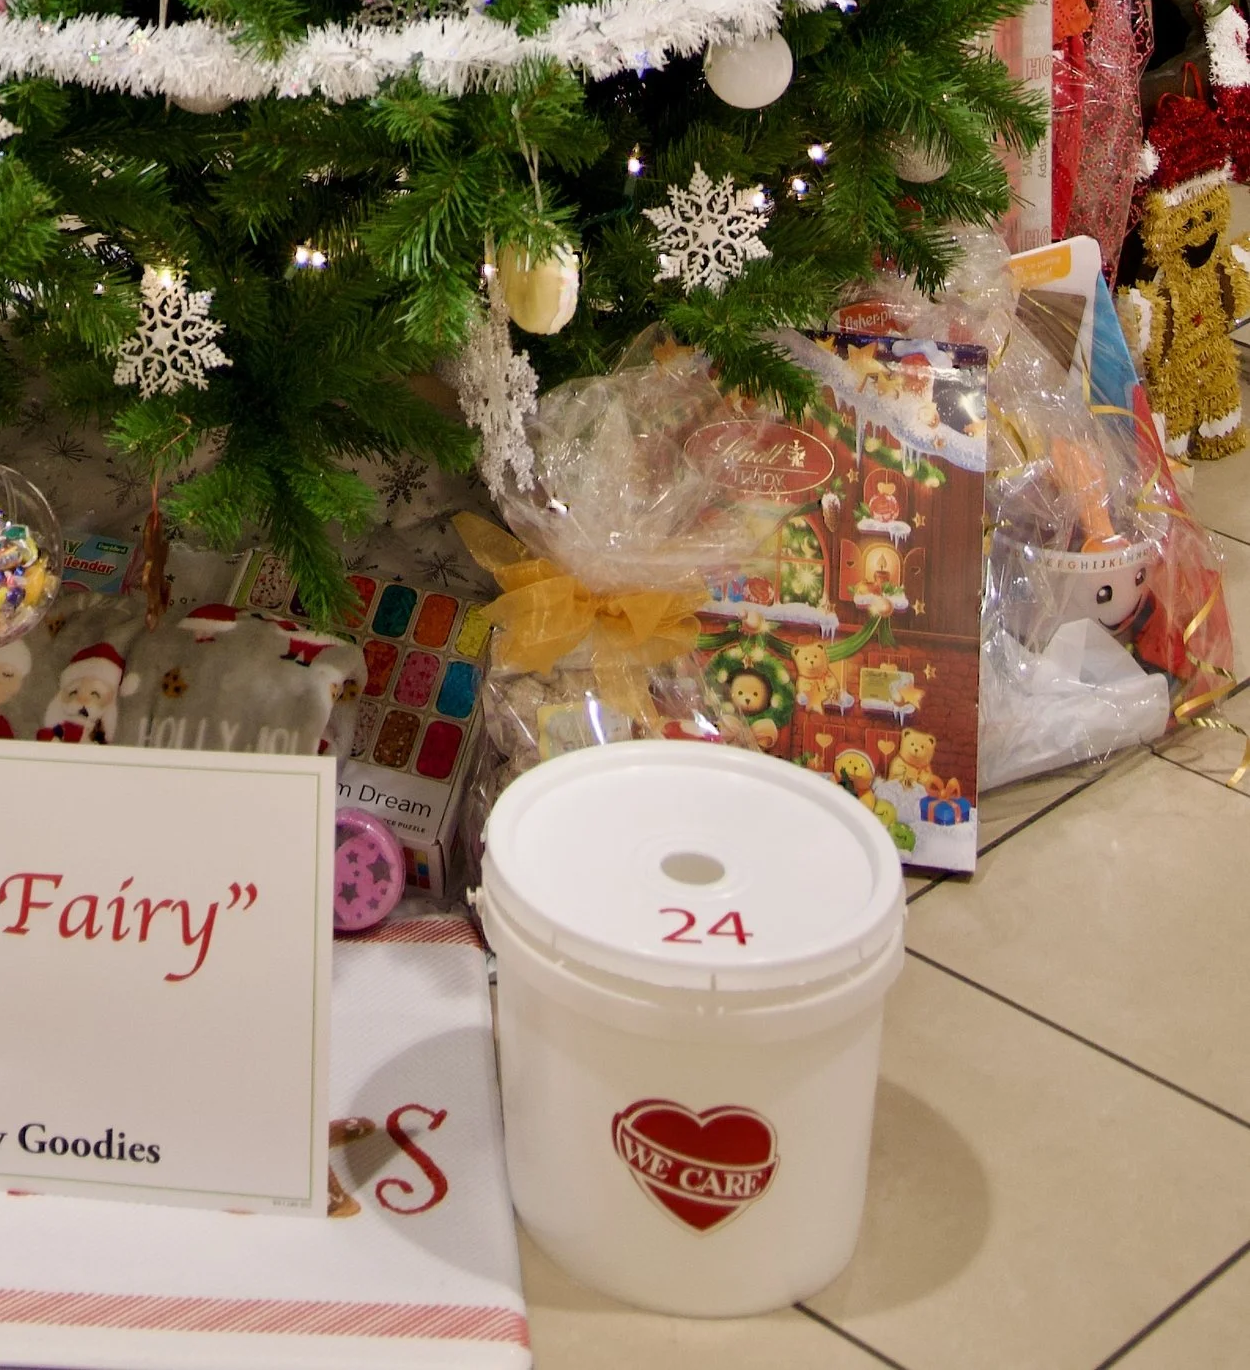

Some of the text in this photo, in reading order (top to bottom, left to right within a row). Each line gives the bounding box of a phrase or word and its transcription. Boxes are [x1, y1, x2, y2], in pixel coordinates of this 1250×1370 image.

[358, 783, 432, 819] Dream
[397, 820, 426, 834] PUZZLE
[658, 906, 755, 947] 24
[17, 1121, 162, 1165] Goodies
[620, 1133, 764, 1198] WE CARE
